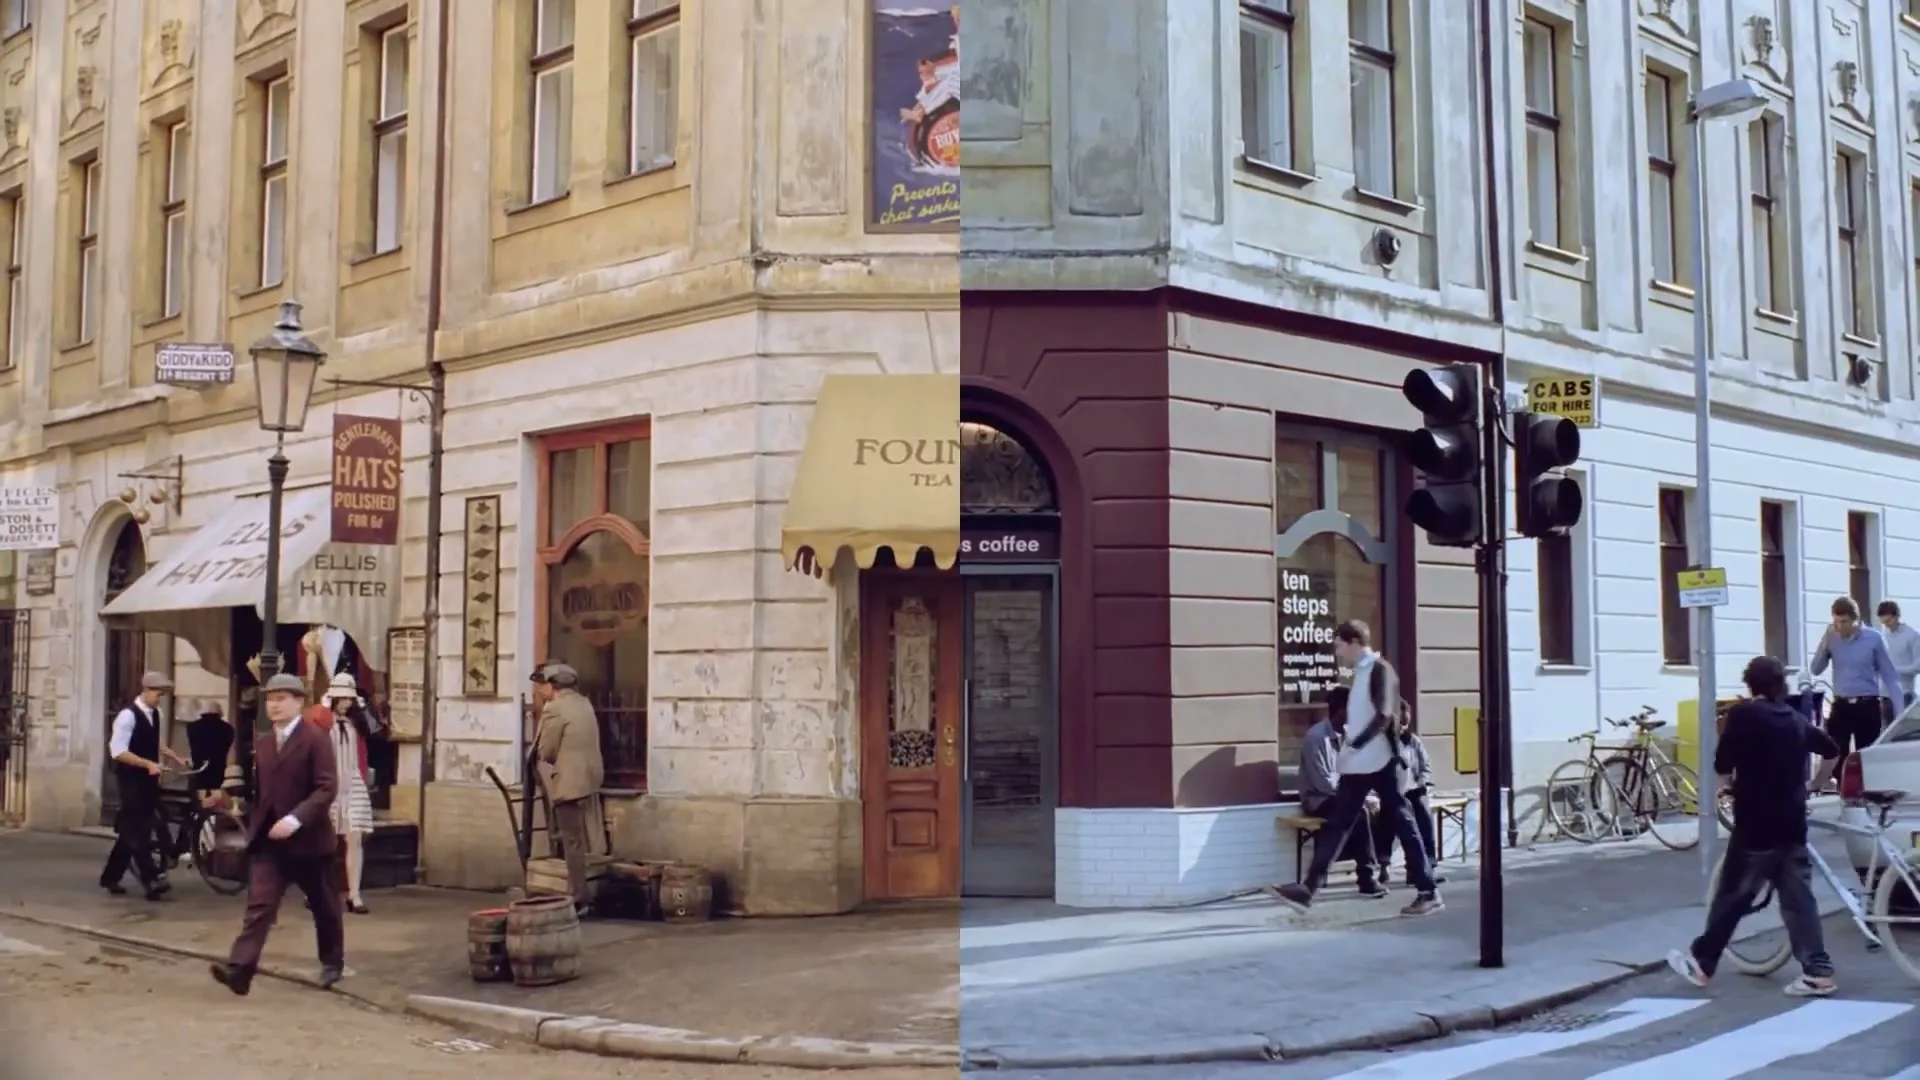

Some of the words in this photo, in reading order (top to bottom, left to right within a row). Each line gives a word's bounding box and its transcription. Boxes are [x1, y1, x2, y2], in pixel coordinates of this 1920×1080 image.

[889, 182, 957, 205] Prevents
[1534, 380, 1592, 398] CABS
[1533, 402, 1557, 413] FOR
[1562, 400, 1591, 412] HIRE
[335, 422, 400, 455] GENTLEMAN'S
[335, 454, 398, 490] HATS
[910, 473, 952, 487] TEA
[25, 497, 50, 505] LET
[334, 491, 396, 511] POLISHED
[9, 523, 57, 534] DOSETT
[347, 513, 368, 527] FOR
[979, 535, 1040, 552] coffee
[315, 554, 377, 571] ELLIS
[301, 579, 387, 597] HATTER
[1282, 569, 1309, 591] ten
[1283, 594, 1329, 620] steps
[1283, 620, 1334, 643] coffee
